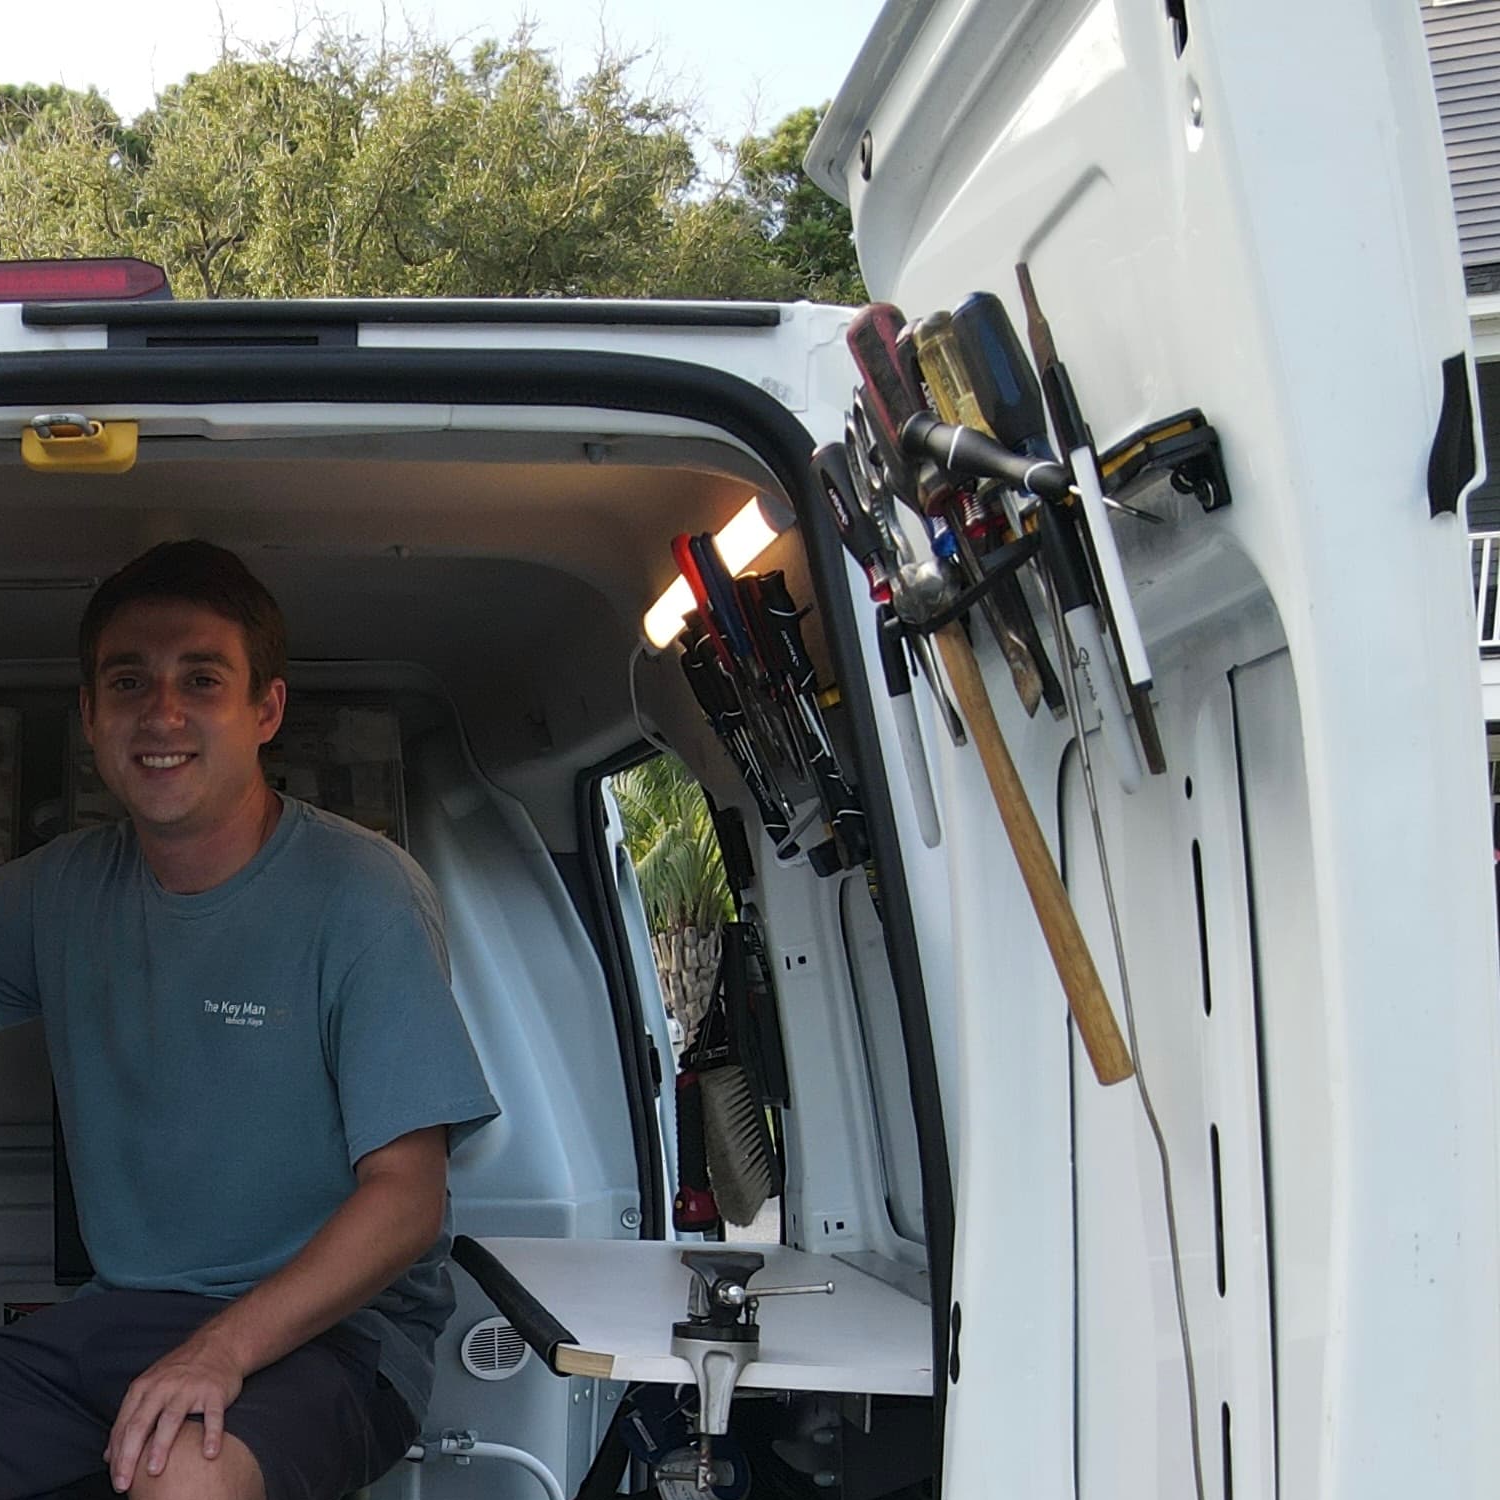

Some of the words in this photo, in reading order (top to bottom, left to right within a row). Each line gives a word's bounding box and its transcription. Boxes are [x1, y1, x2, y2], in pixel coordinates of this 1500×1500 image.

[204, 1000, 219, 1013] The
[221, 1001, 241, 1019] Key
[243, 1002, 266, 1016] Man
